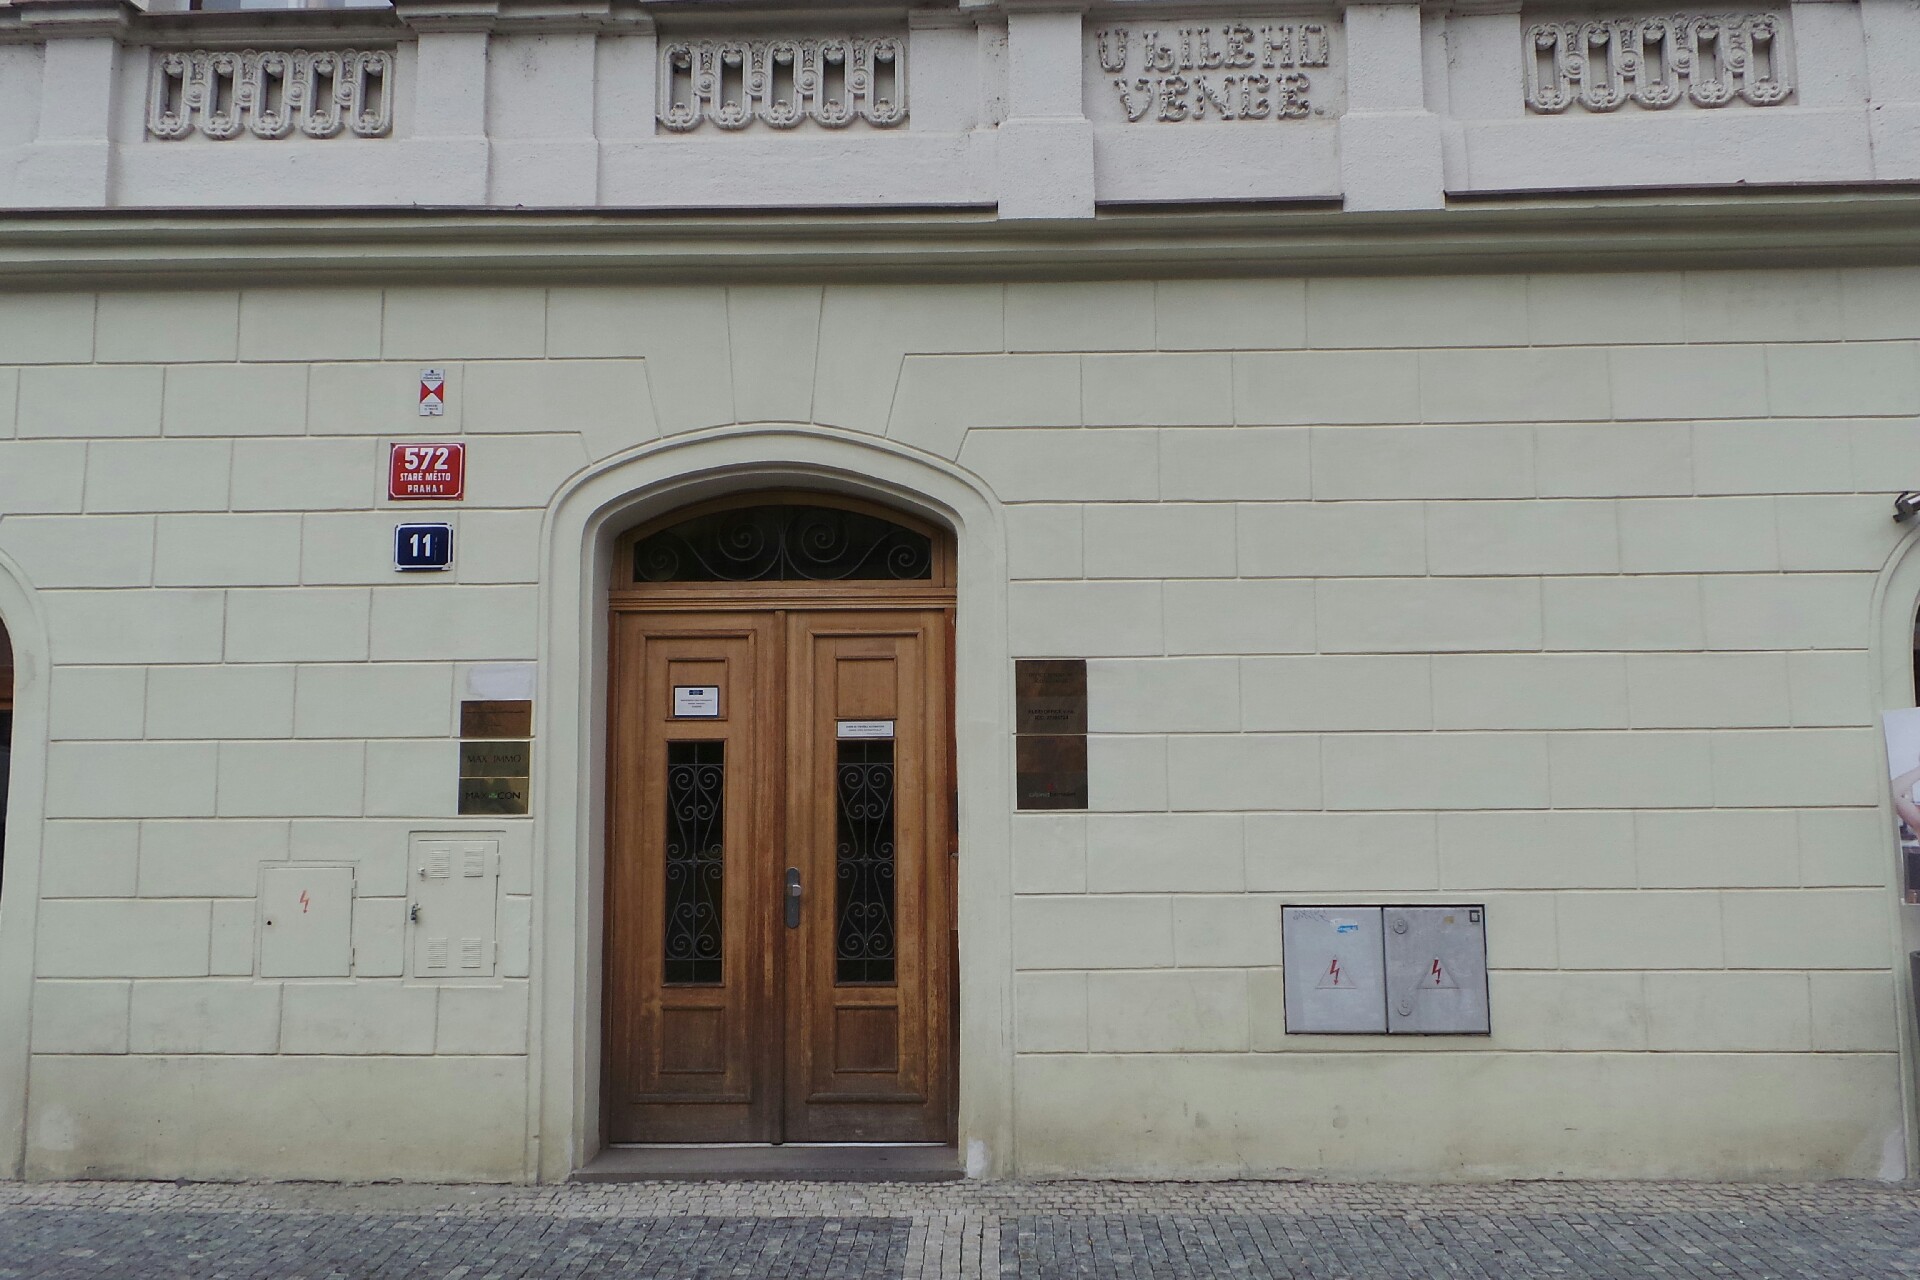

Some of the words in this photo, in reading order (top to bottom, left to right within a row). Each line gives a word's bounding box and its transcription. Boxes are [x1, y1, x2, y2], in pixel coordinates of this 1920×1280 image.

[1097, 27, 1129, 72] U
[404, 447, 449, 470] 572
[400, 471, 423, 481] STARÉ
[425, 470, 451, 481] MĚSTO
[407, 484, 437, 493] PRAHA
[439, 484, 444, 493] 1
[409, 533, 431, 557] 11
[498, 791, 520, 799] CON
